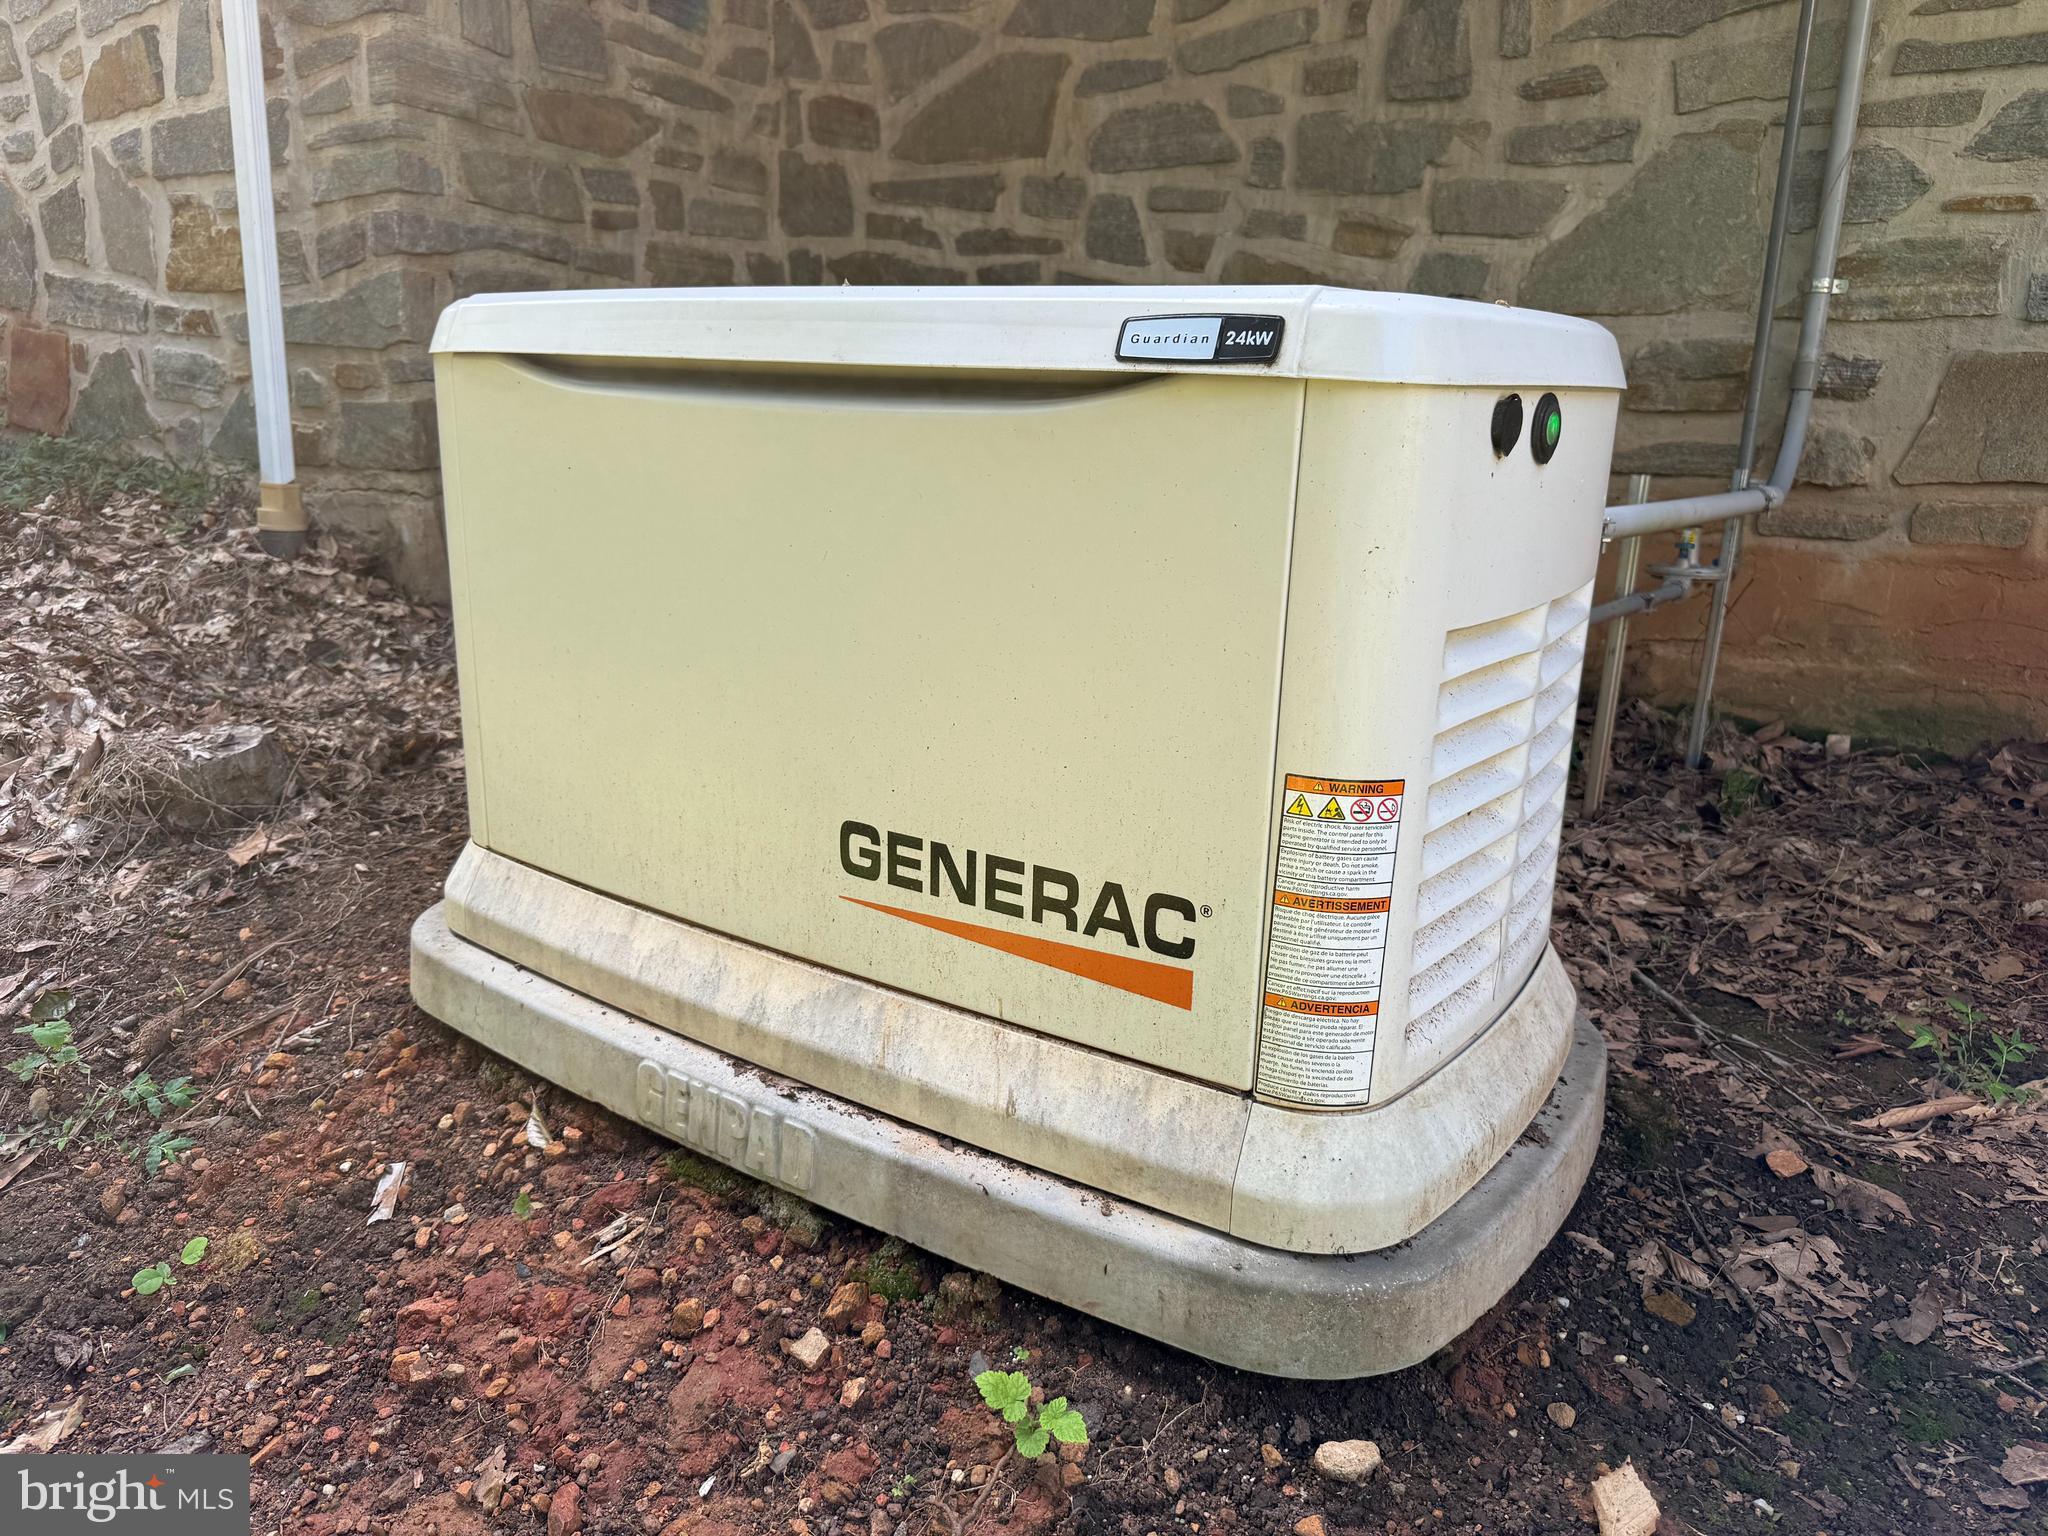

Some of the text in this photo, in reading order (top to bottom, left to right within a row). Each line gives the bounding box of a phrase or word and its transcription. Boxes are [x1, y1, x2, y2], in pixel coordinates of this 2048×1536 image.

[1130, 331, 1274, 346] Guardian 24kW
[1329, 784, 1384, 794] WARNING
[1293, 898, 1387, 910] AVERTISSEMENT
[1268, 980, 1285, 988] Cancer
[1291, 1000, 1370, 1014] ADVERTENCIA
[1291, 1014, 1315, 1022] descarga
[1275, 1030, 1301, 1039] destinado
